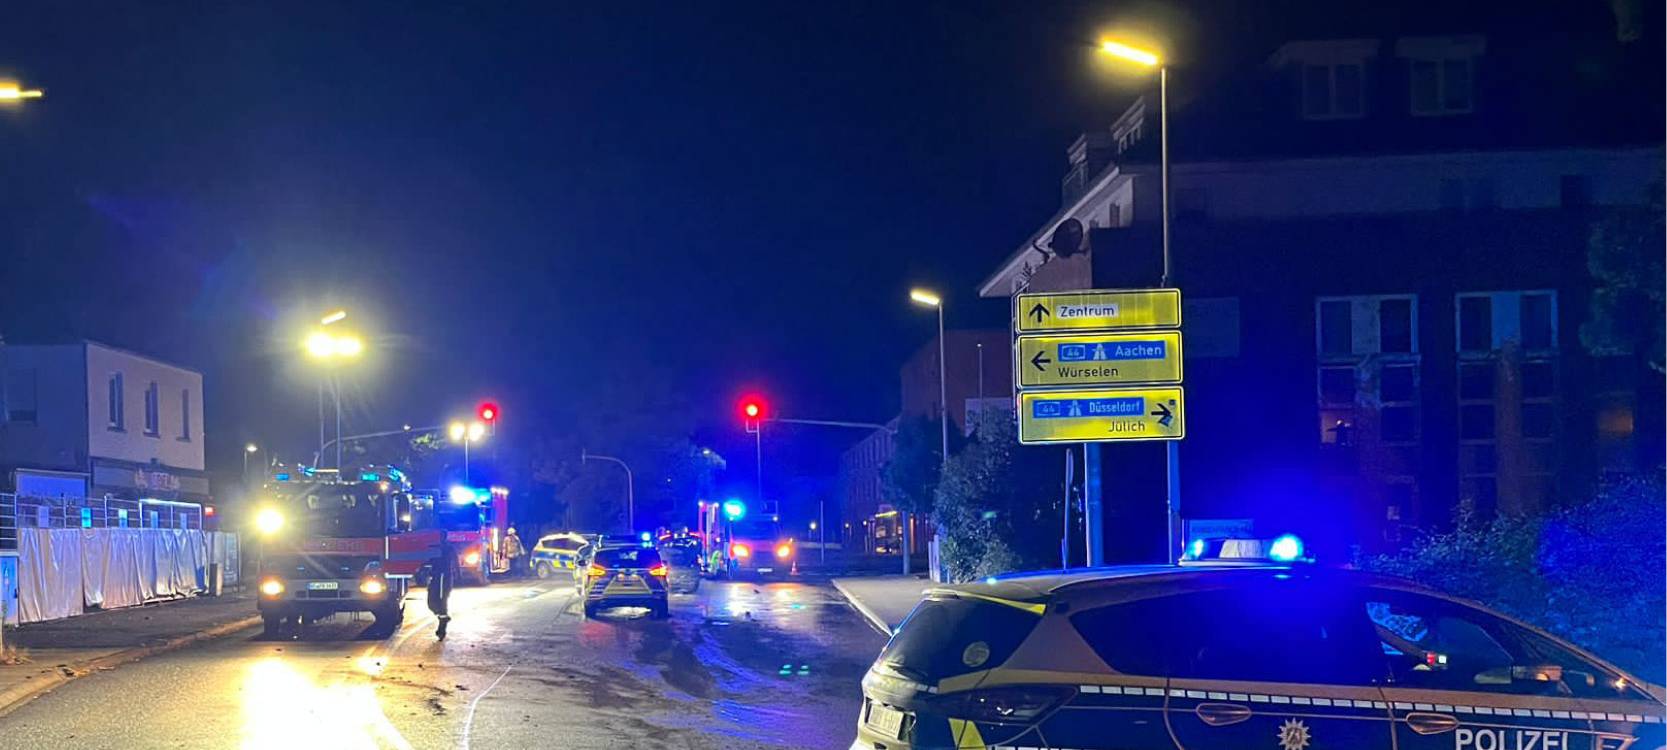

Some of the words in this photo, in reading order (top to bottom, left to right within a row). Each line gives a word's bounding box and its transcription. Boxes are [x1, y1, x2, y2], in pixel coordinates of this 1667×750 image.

[1060, 306, 1114, 317] Zentrum
[1115, 345, 1162, 357] Aachen
[1089, 402, 1140, 413] Düsseldorf
[1455, 729, 1568, 750] POLIZEI
